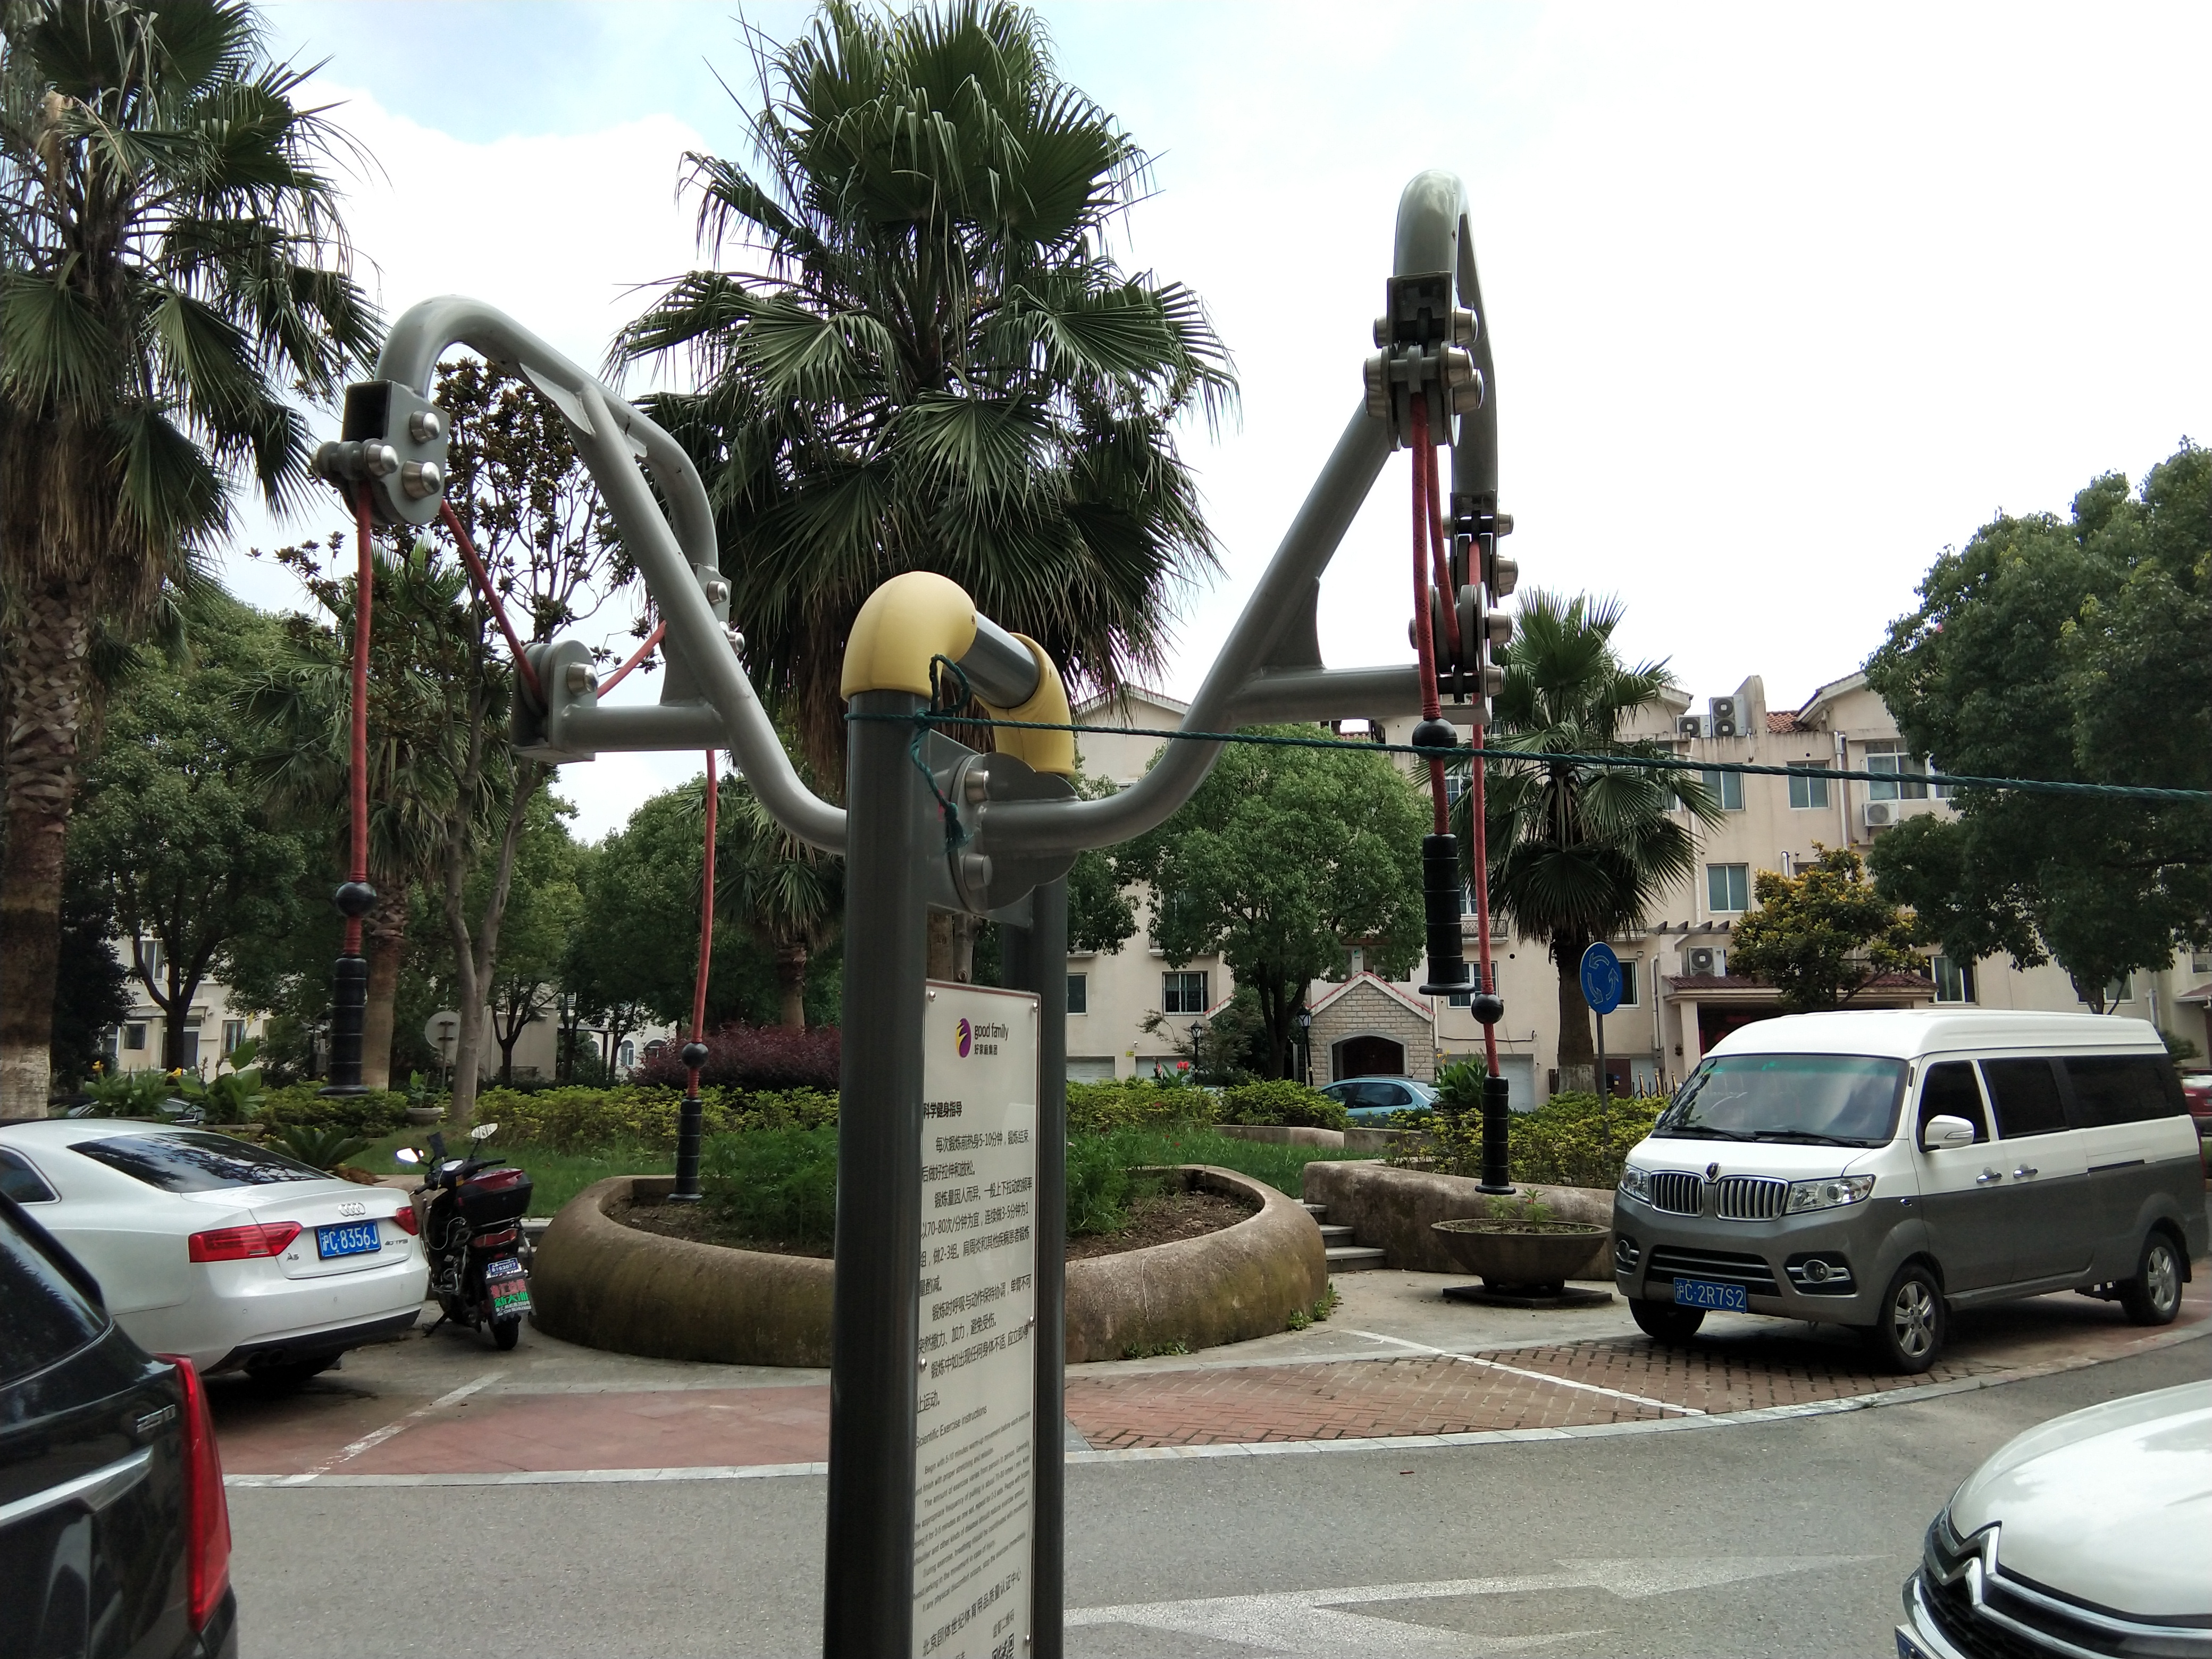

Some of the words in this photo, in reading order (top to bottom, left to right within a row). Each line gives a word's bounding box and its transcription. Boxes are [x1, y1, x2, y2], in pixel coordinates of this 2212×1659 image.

[974, 1023, 990, 1040] good
[991, 1023, 1009, 1041] family
[974, 1044, 998, 1055] 好家庭集团
[924, 1101, 962, 1119] 科学健身指导
[1676, 1282, 1745, 1309] 沪C·2R7S2
[917, 1427, 939, 1448] Scientific
[940, 1418, 961, 1436] Exercise
[925, 1460, 936, 1476] Begin
